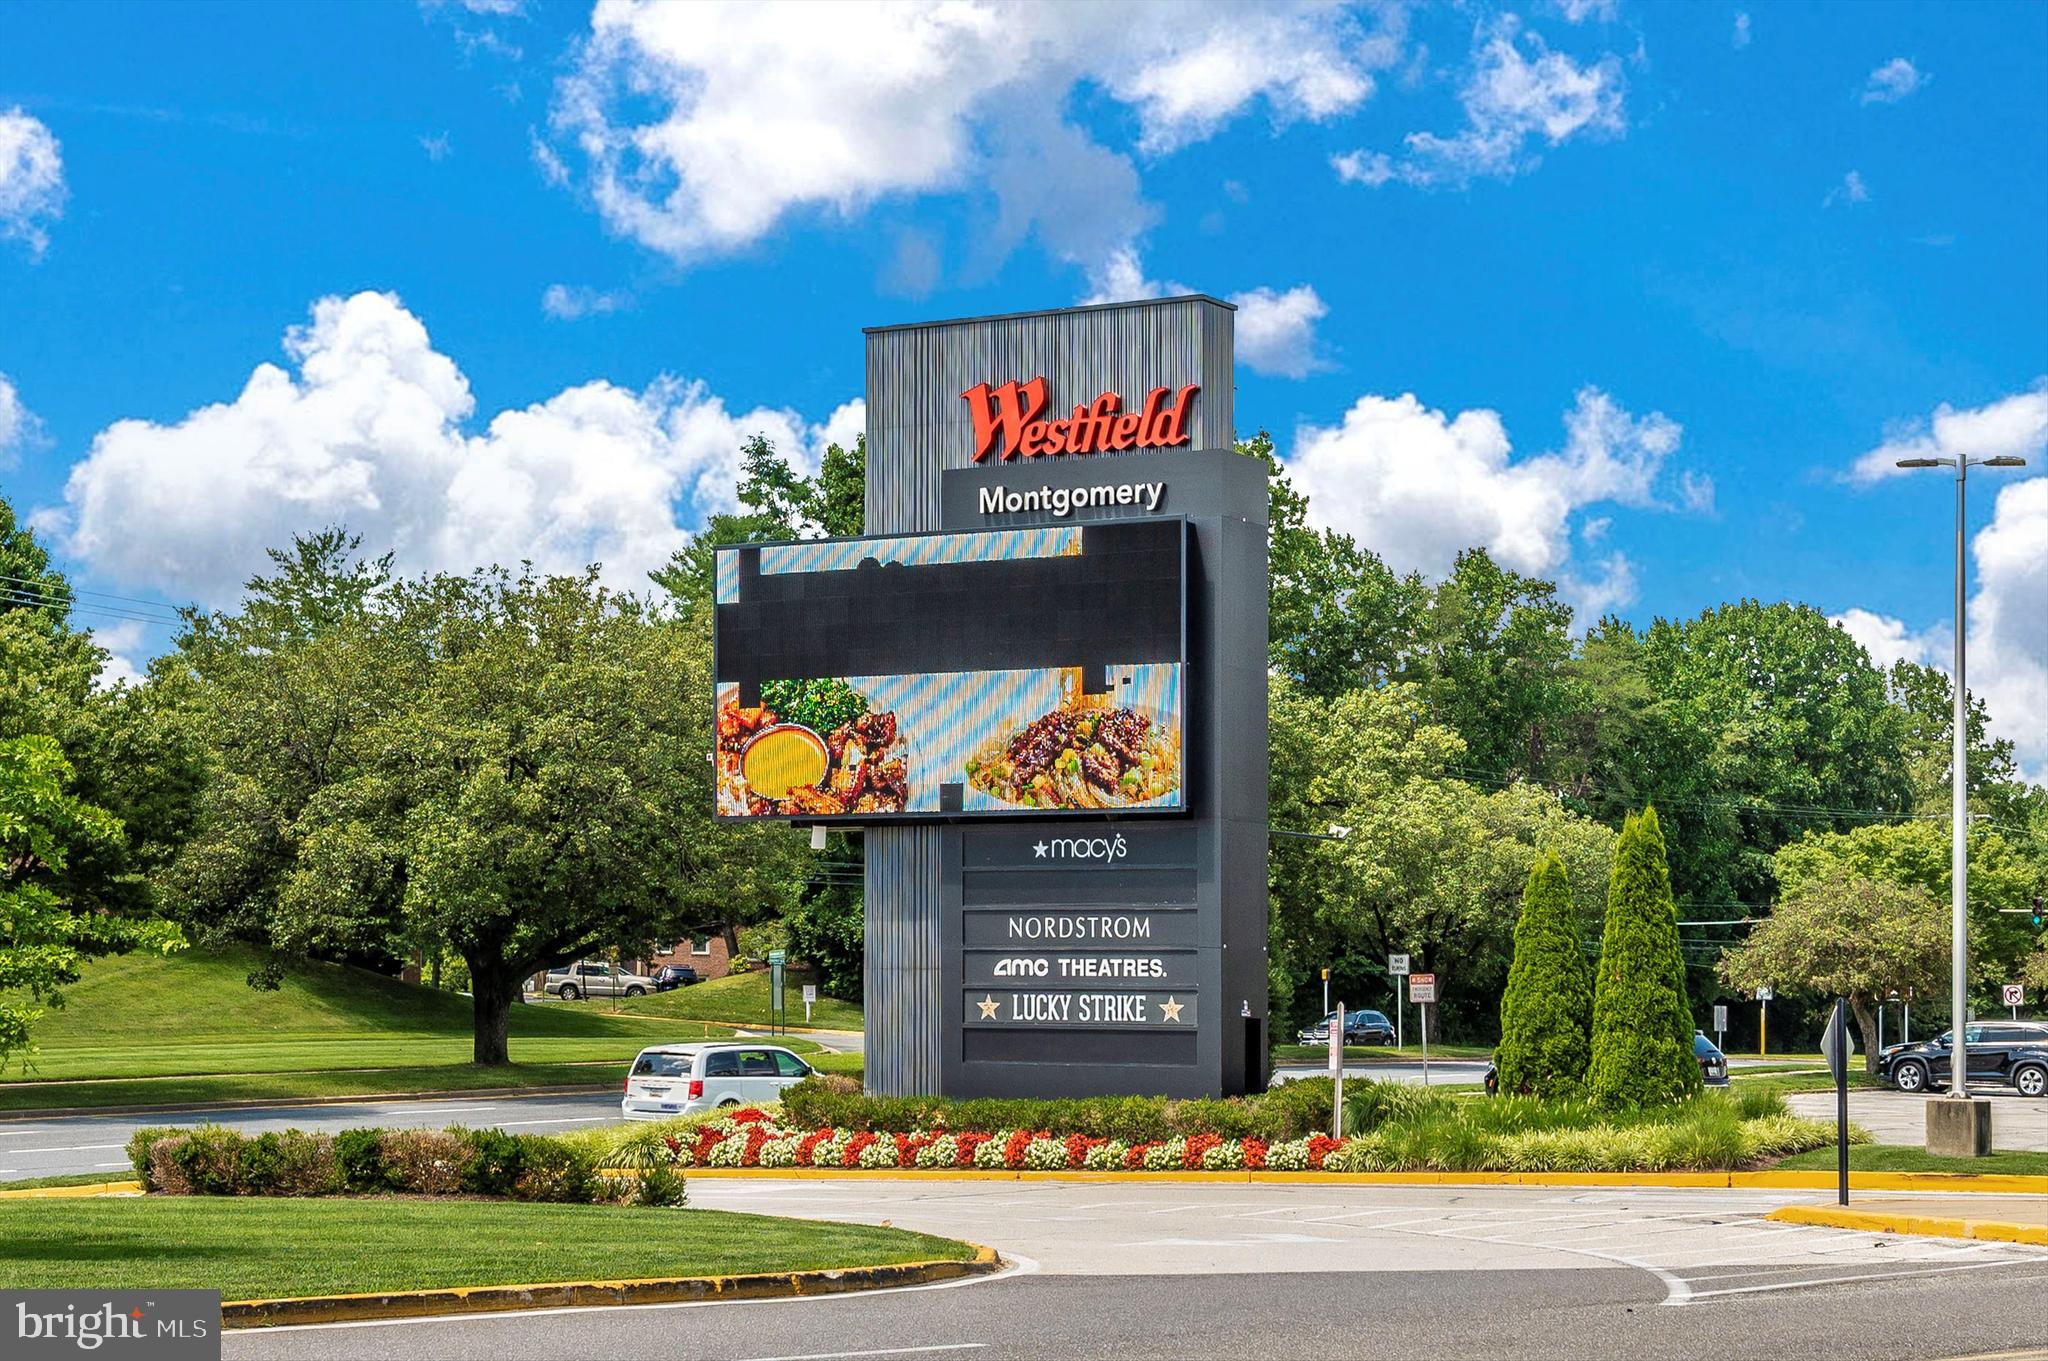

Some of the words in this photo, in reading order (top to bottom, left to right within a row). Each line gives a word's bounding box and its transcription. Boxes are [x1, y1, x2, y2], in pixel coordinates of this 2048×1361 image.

[960, 376, 1200, 462] Westfield
[979, 481, 1163, 516] Montgomery
[1051, 833, 1127, 863] macy's
[1009, 917, 1150, 938] NORDSTROM
[1012, 994, 1072, 1021] LUCKY
[1078, 994, 1147, 1022] STRIKE
